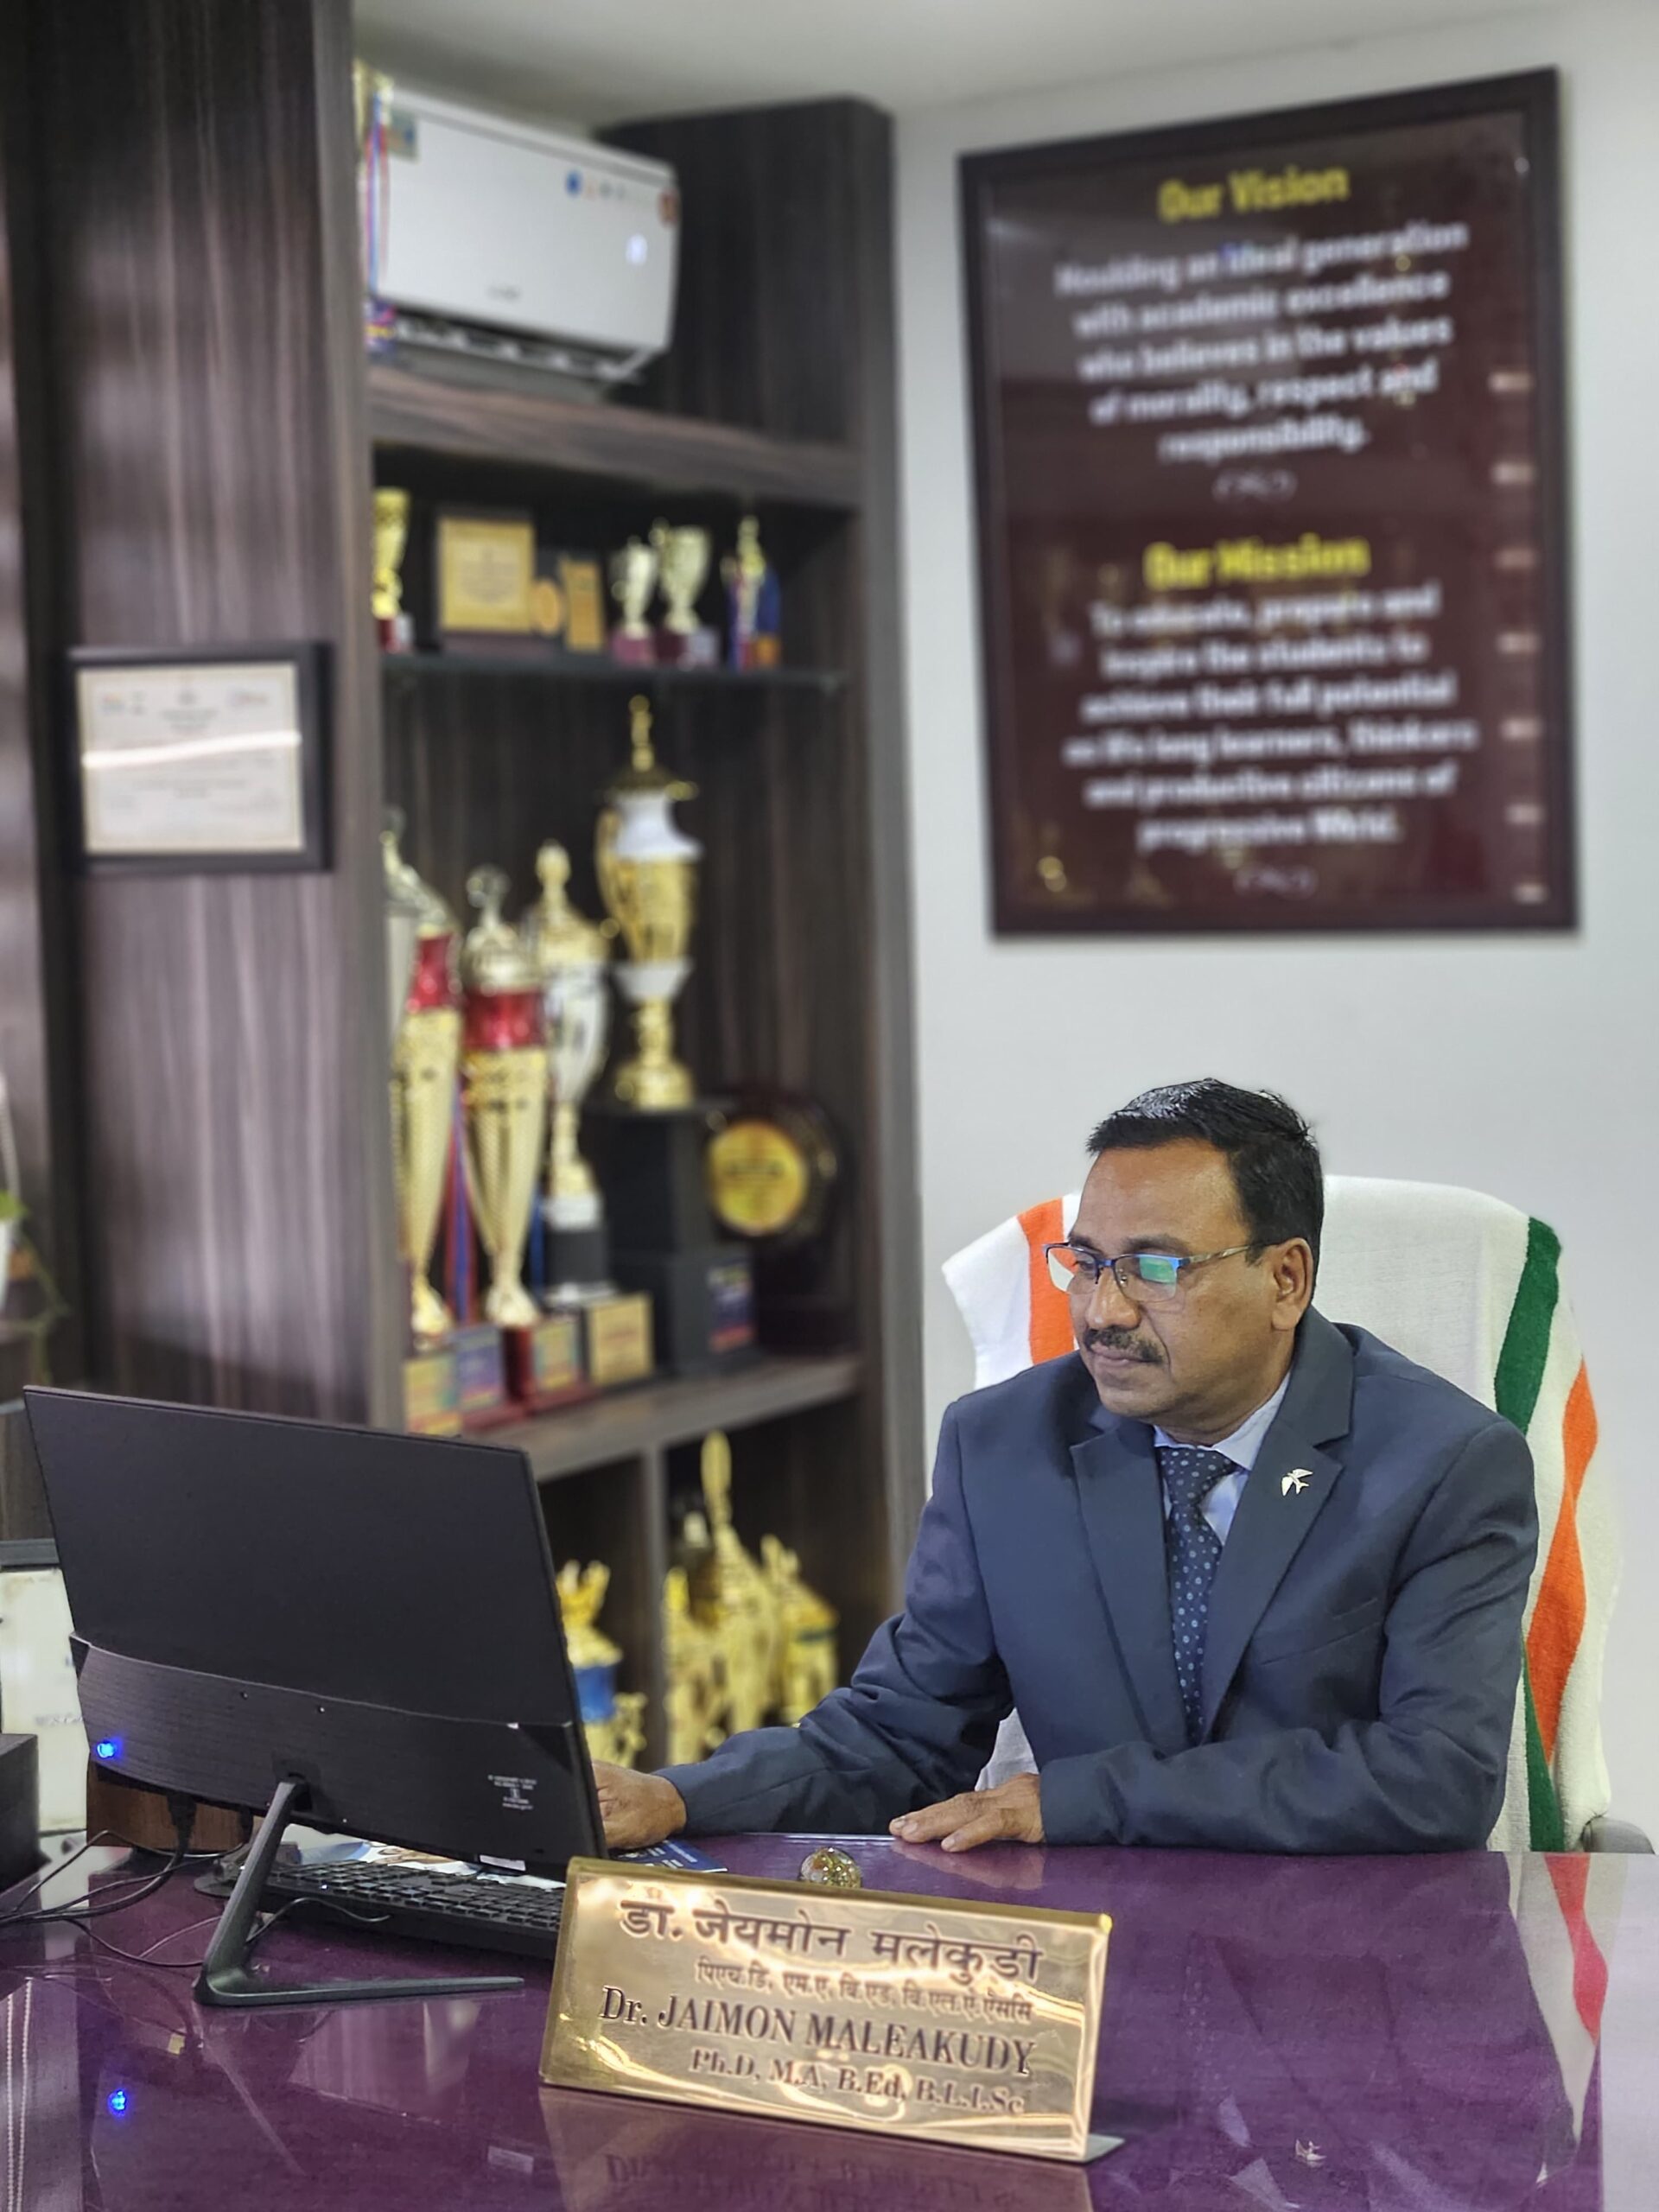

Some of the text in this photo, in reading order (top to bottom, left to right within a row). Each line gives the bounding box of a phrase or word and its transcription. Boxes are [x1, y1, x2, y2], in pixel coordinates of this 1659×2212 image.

[1159, 165, 1350, 223] Our Vision
[1303, 220, 1470, 271] generation
[1140, 288, 1278, 332] academic
[1285, 270, 1451, 316] excellence
[1143, 531, 1371, 591] Our Mission
[692, 1898, 852, 1956] जेयमोन
[870, 1923, 1044, 1986] मलेकुडी
[600, 1986, 1035, 2075] Dr. JAIMON MALEAKUDY
